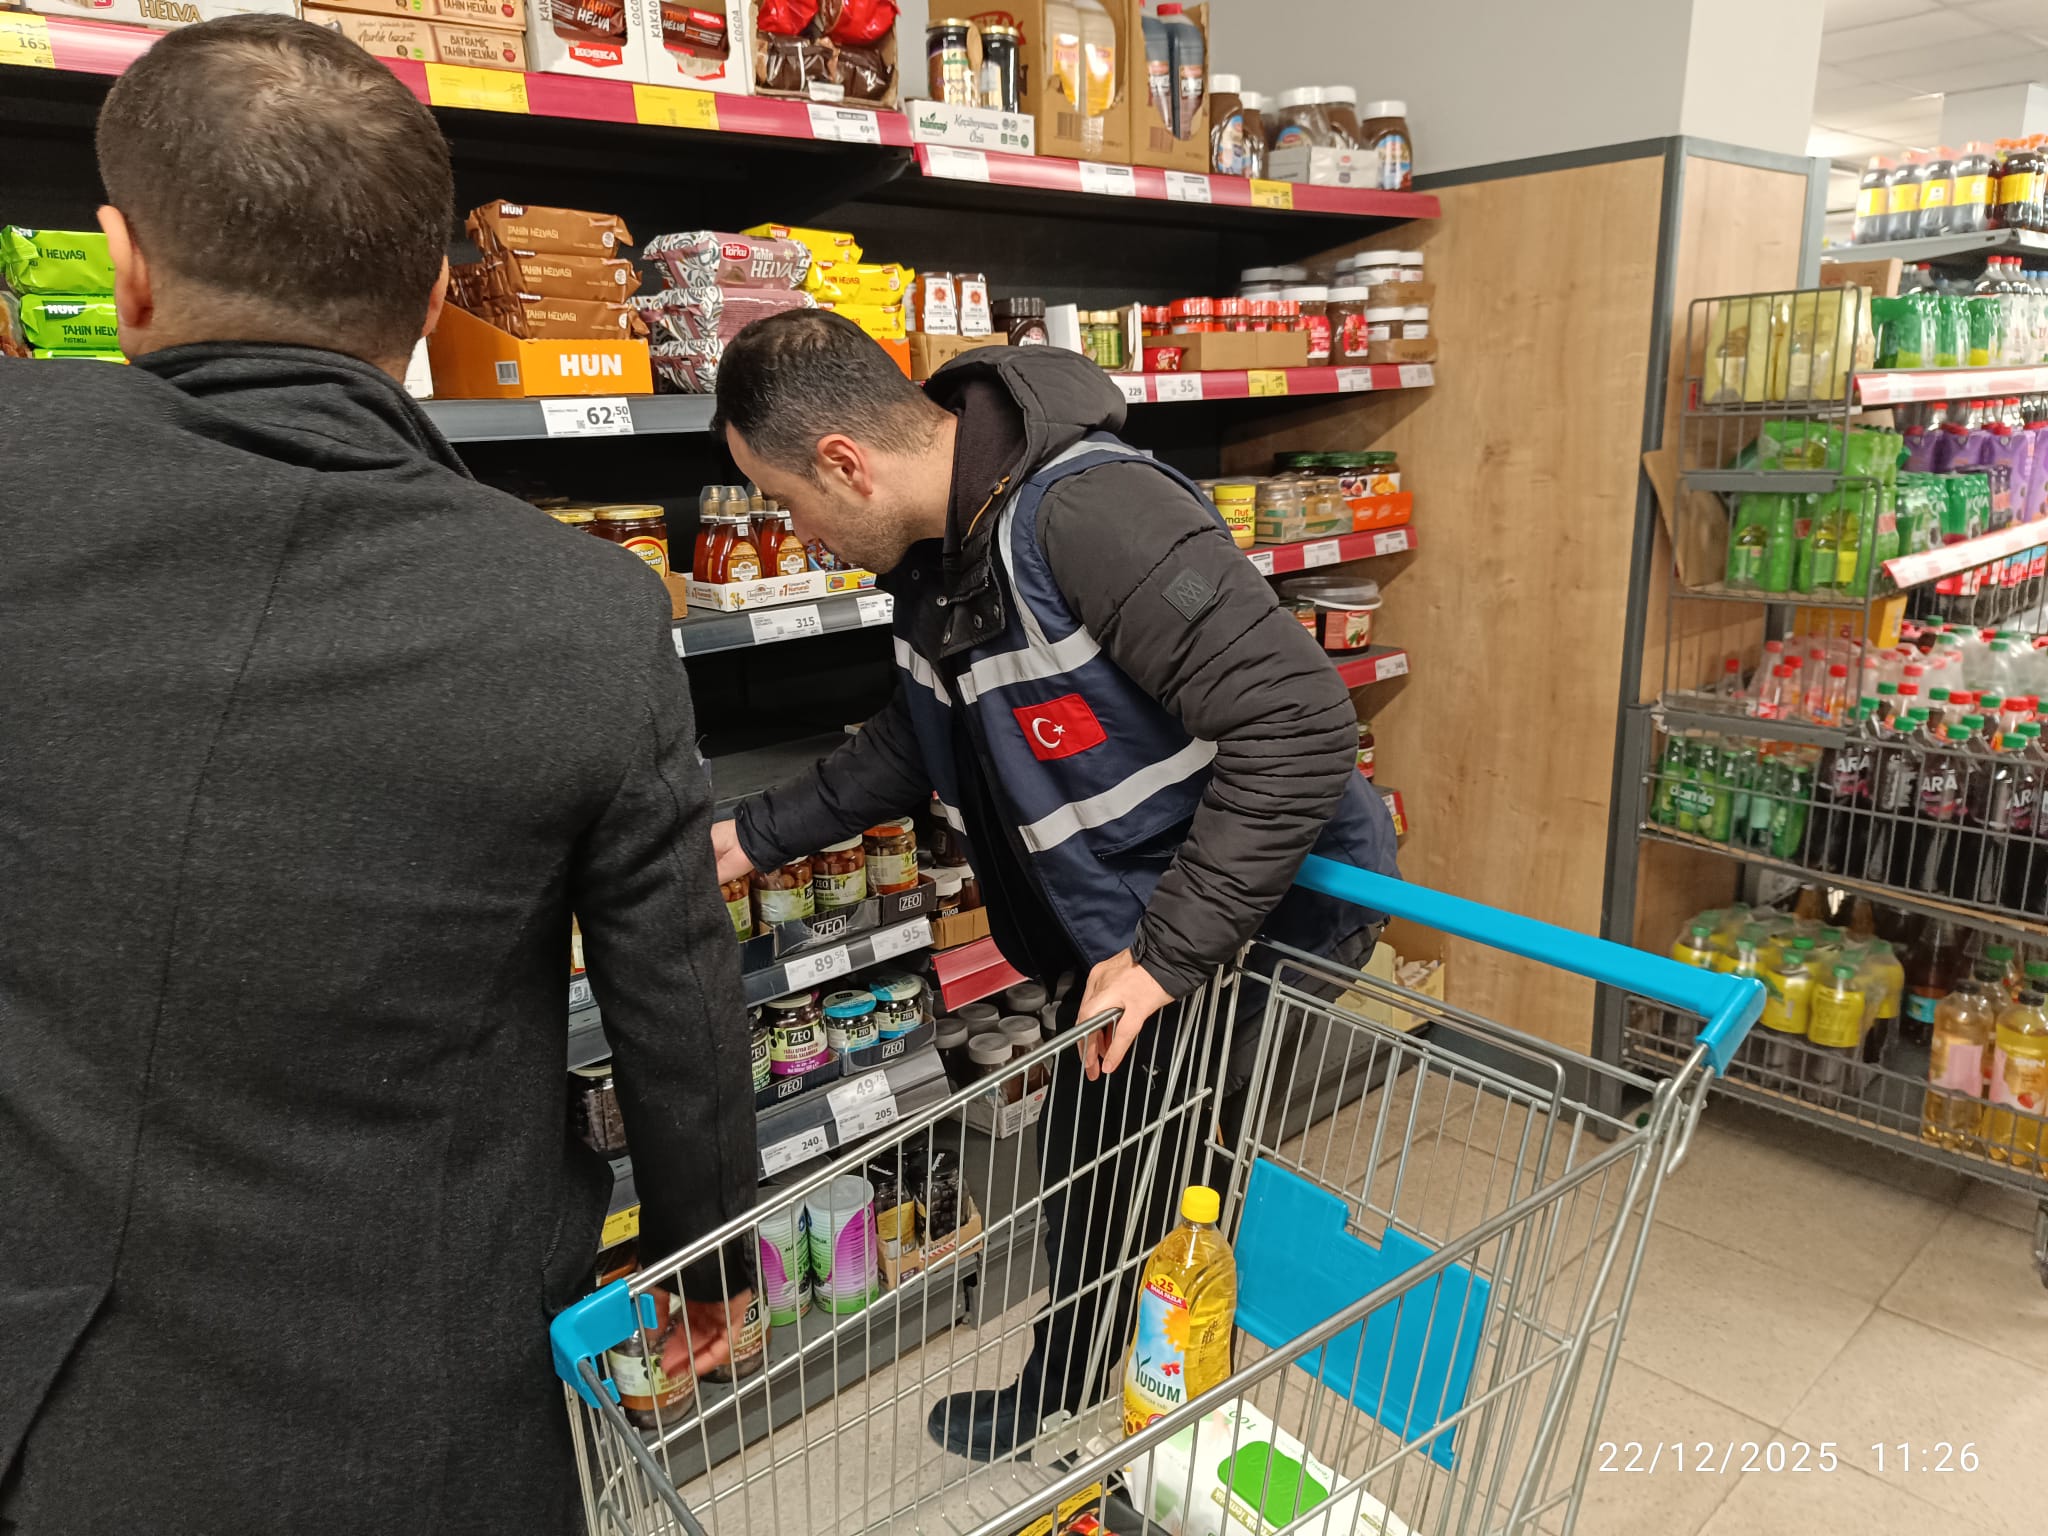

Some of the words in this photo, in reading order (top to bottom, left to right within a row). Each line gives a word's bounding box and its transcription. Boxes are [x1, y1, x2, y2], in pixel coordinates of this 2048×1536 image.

[138, 0, 206, 23] HELVA
[577, 7, 611, 32] HELVA
[630, 0, 641, 27] COCO
[573, 46, 619, 62] KOSKA
[501, 204, 524, 216] HUN
[46, 248, 87, 261] HELVASI
[724, 245, 748, 257] Torku
[750, 260, 794, 279] HELVA
[94, 325, 118, 337] HELV
[559, 352, 623, 377] HUN
[1180, 379, 1194, 393] 55
[1224, 515, 1255, 524] maste
[795, 617, 816, 629] 315
[901, 895, 920, 910] ZEO
[816, 918, 844, 936] ZEO
[902, 926, 921, 942] 95
[790, 1029, 811, 1044] ZEO
[884, 1040, 902, 1057] ZEO
[780, 1080, 800, 1096] ZEO
[875, 1107, 892, 1121] 205
[801, 1135, 819, 1151] 240
[743, 1307, 757, 1324] EO
[1134, 1351, 1181, 1404] YUDUM
